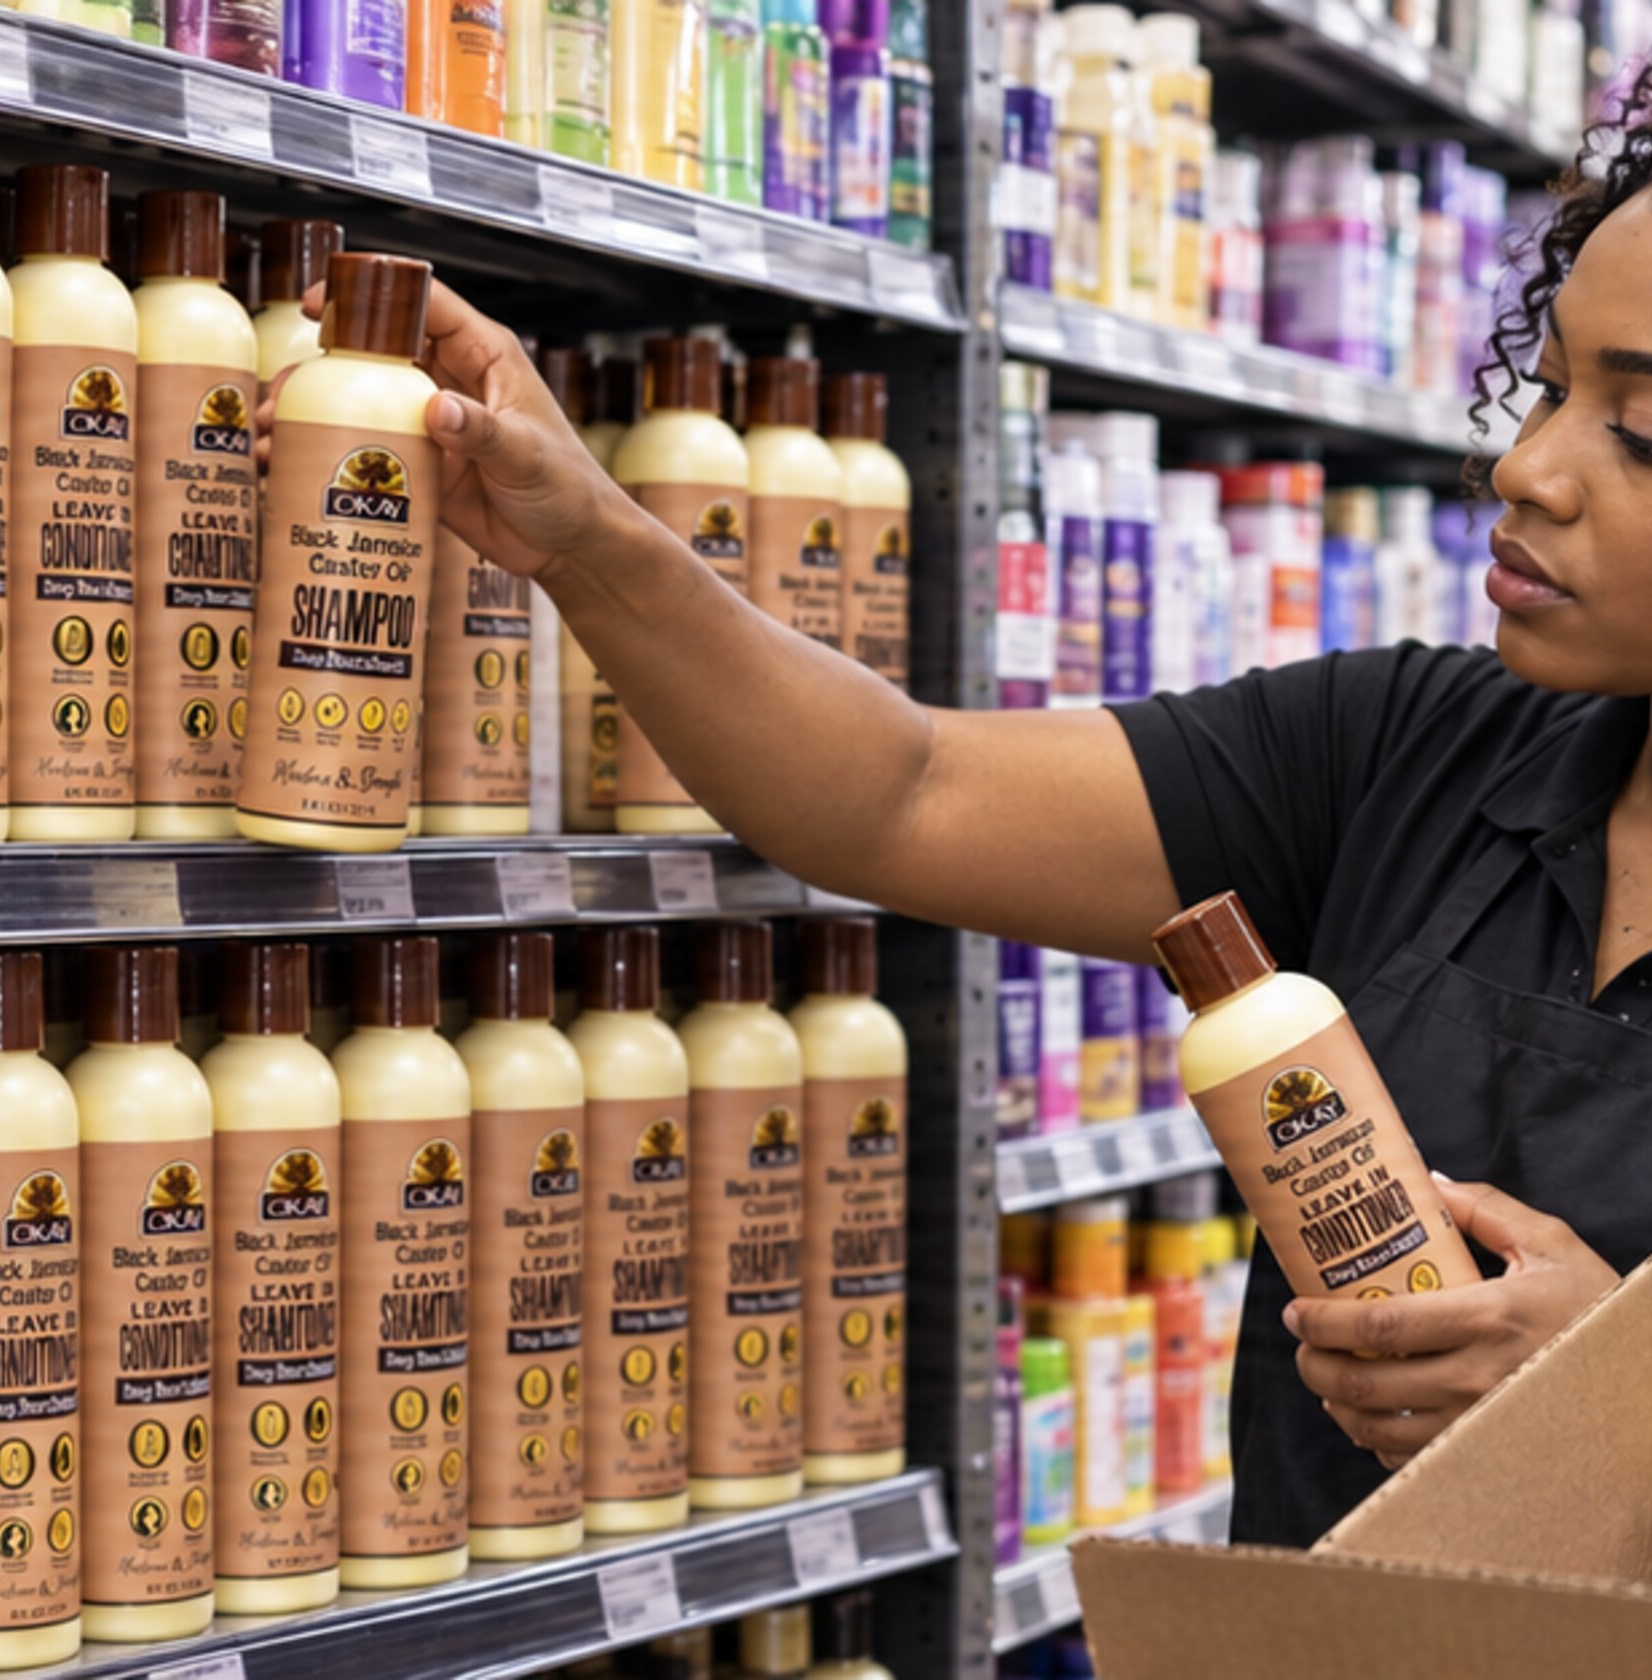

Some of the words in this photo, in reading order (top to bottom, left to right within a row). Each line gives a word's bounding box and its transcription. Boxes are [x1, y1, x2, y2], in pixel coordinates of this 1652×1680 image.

[291, 584, 415, 650] SHAMPOO
[1299, 1178, 1366, 1221] LEAVE
[1367, 1164, 1391, 1188] IN
